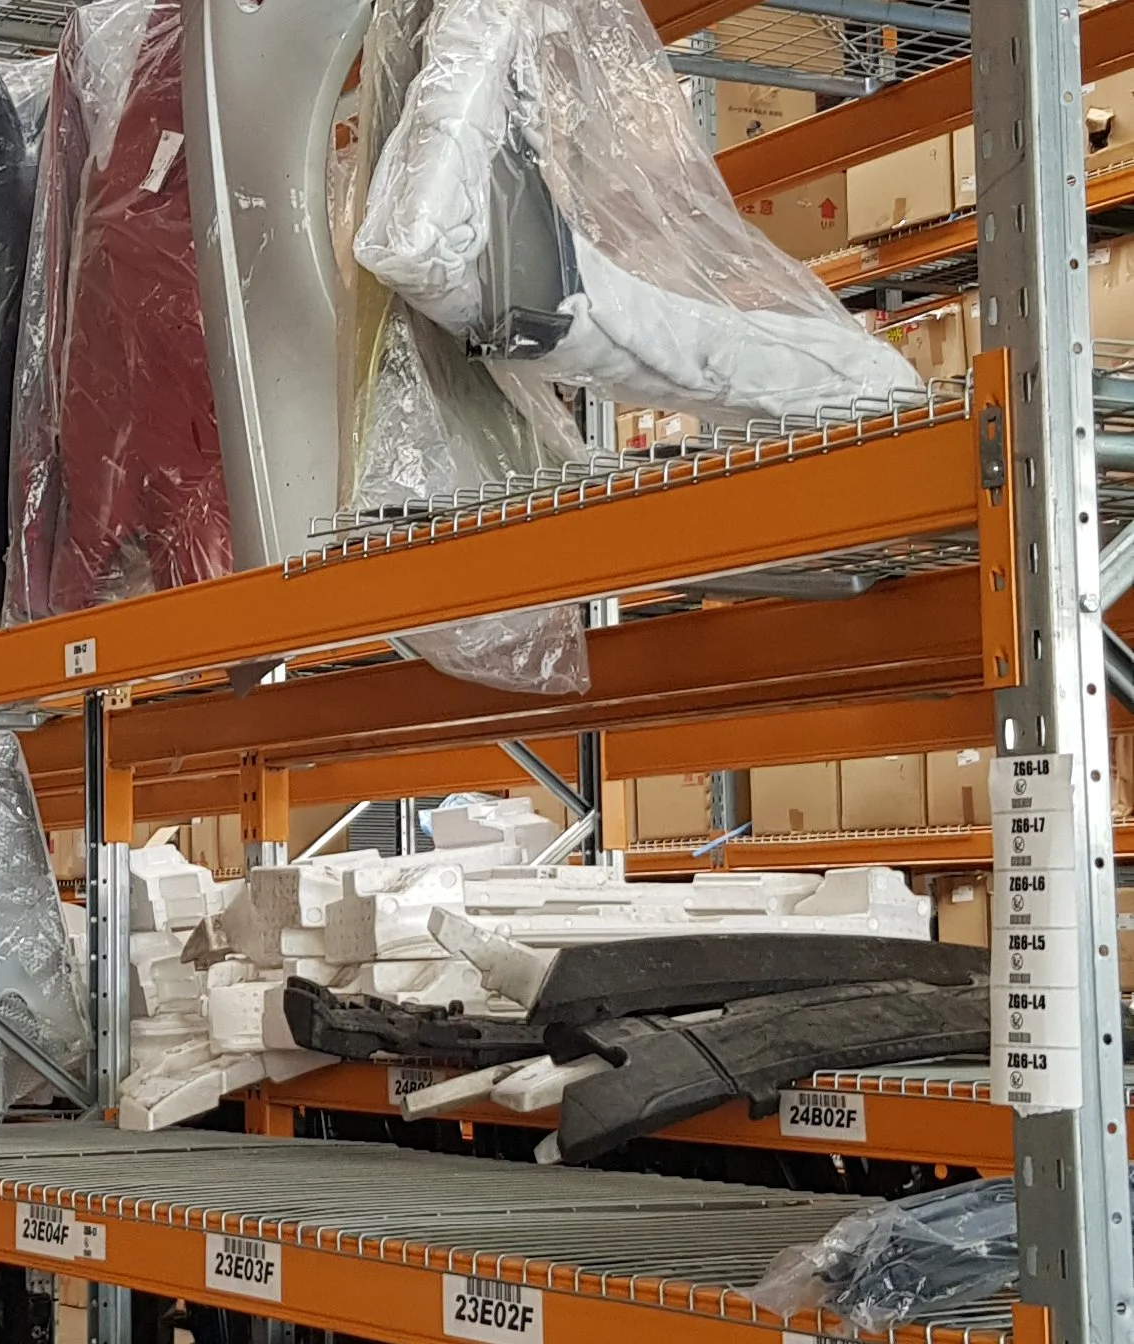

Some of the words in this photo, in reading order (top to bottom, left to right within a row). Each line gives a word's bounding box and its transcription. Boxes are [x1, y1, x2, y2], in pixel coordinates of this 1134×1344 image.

[790, 1105, 857, 1128] 24B02F
[22, 1217, 70, 1246] 23E04F
[215, 1252, 275, 1285] 23E03F
[455, 1294, 534, 1333] 23E02F
